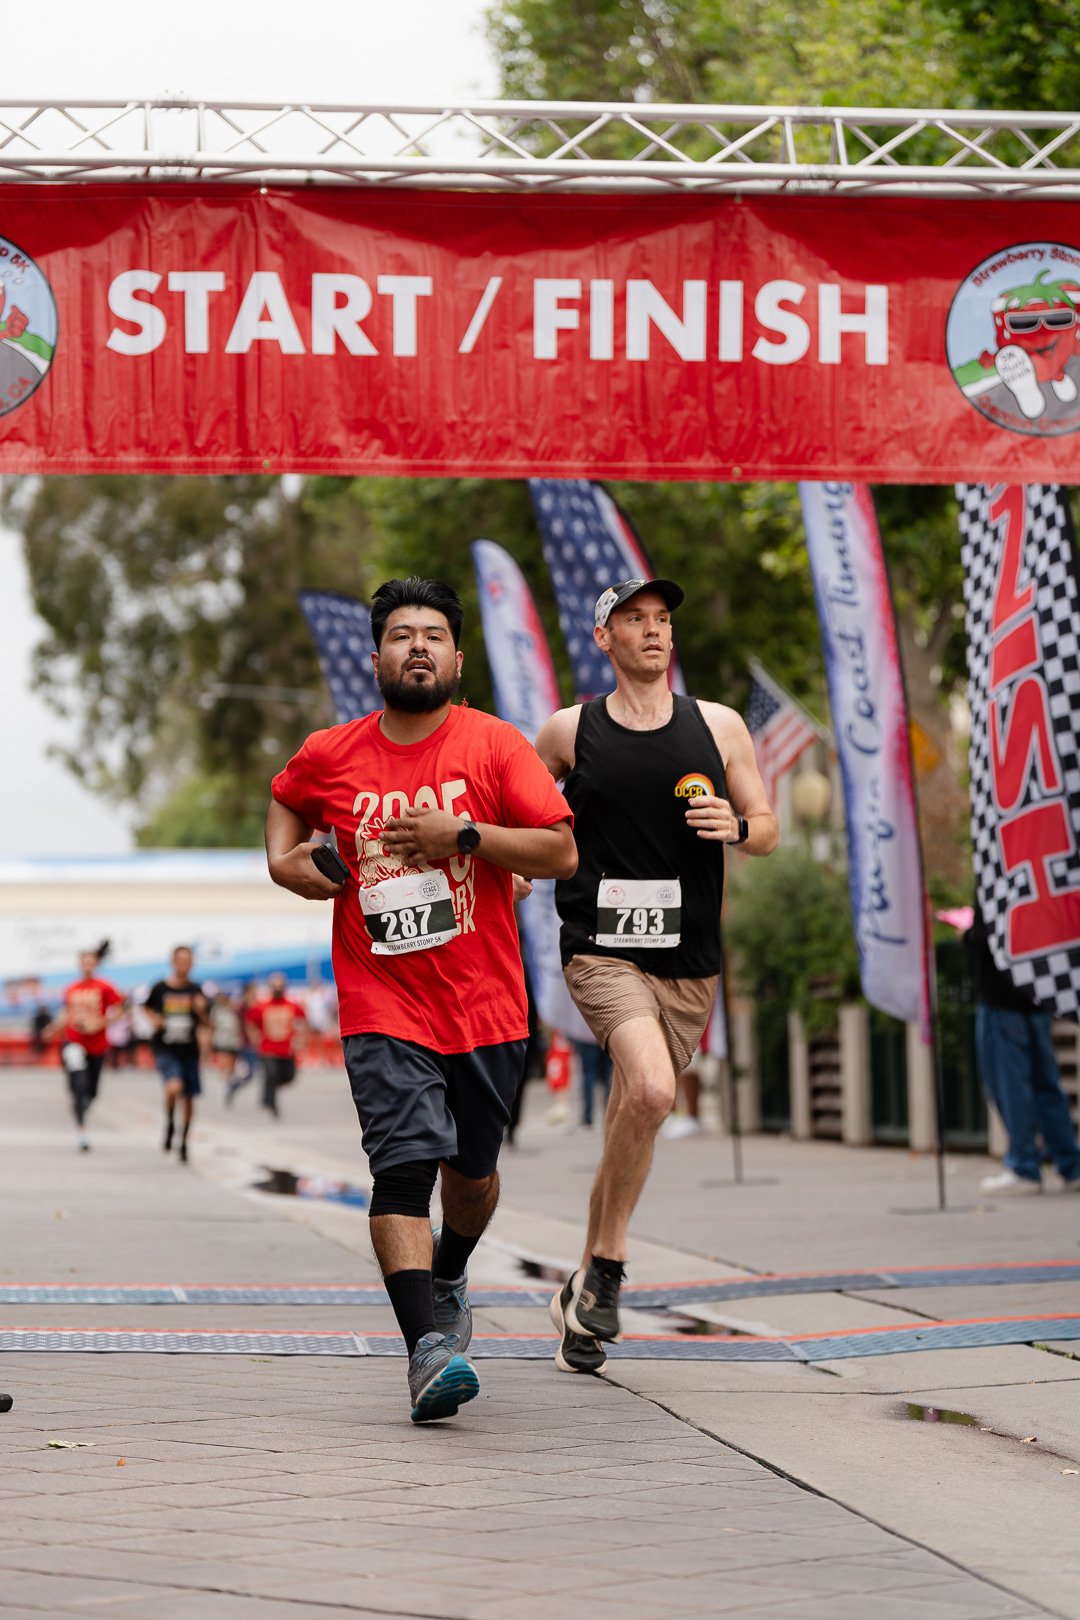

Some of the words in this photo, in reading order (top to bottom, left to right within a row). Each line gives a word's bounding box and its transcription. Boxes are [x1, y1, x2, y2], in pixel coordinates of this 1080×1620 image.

[972, 247, 1046, 287] Strawberry
[105, 269, 433, 356] START
[458, 277, 502, 354] /
[533, 278, 888, 365] FINISH
[833, 629, 880, 756] Coast
[986, 483, 1080, 960] NISH
[381, 904, 432, 941] 287
[616, 908, 665, 935] 793
[417, 938, 434, 947] STOMP
